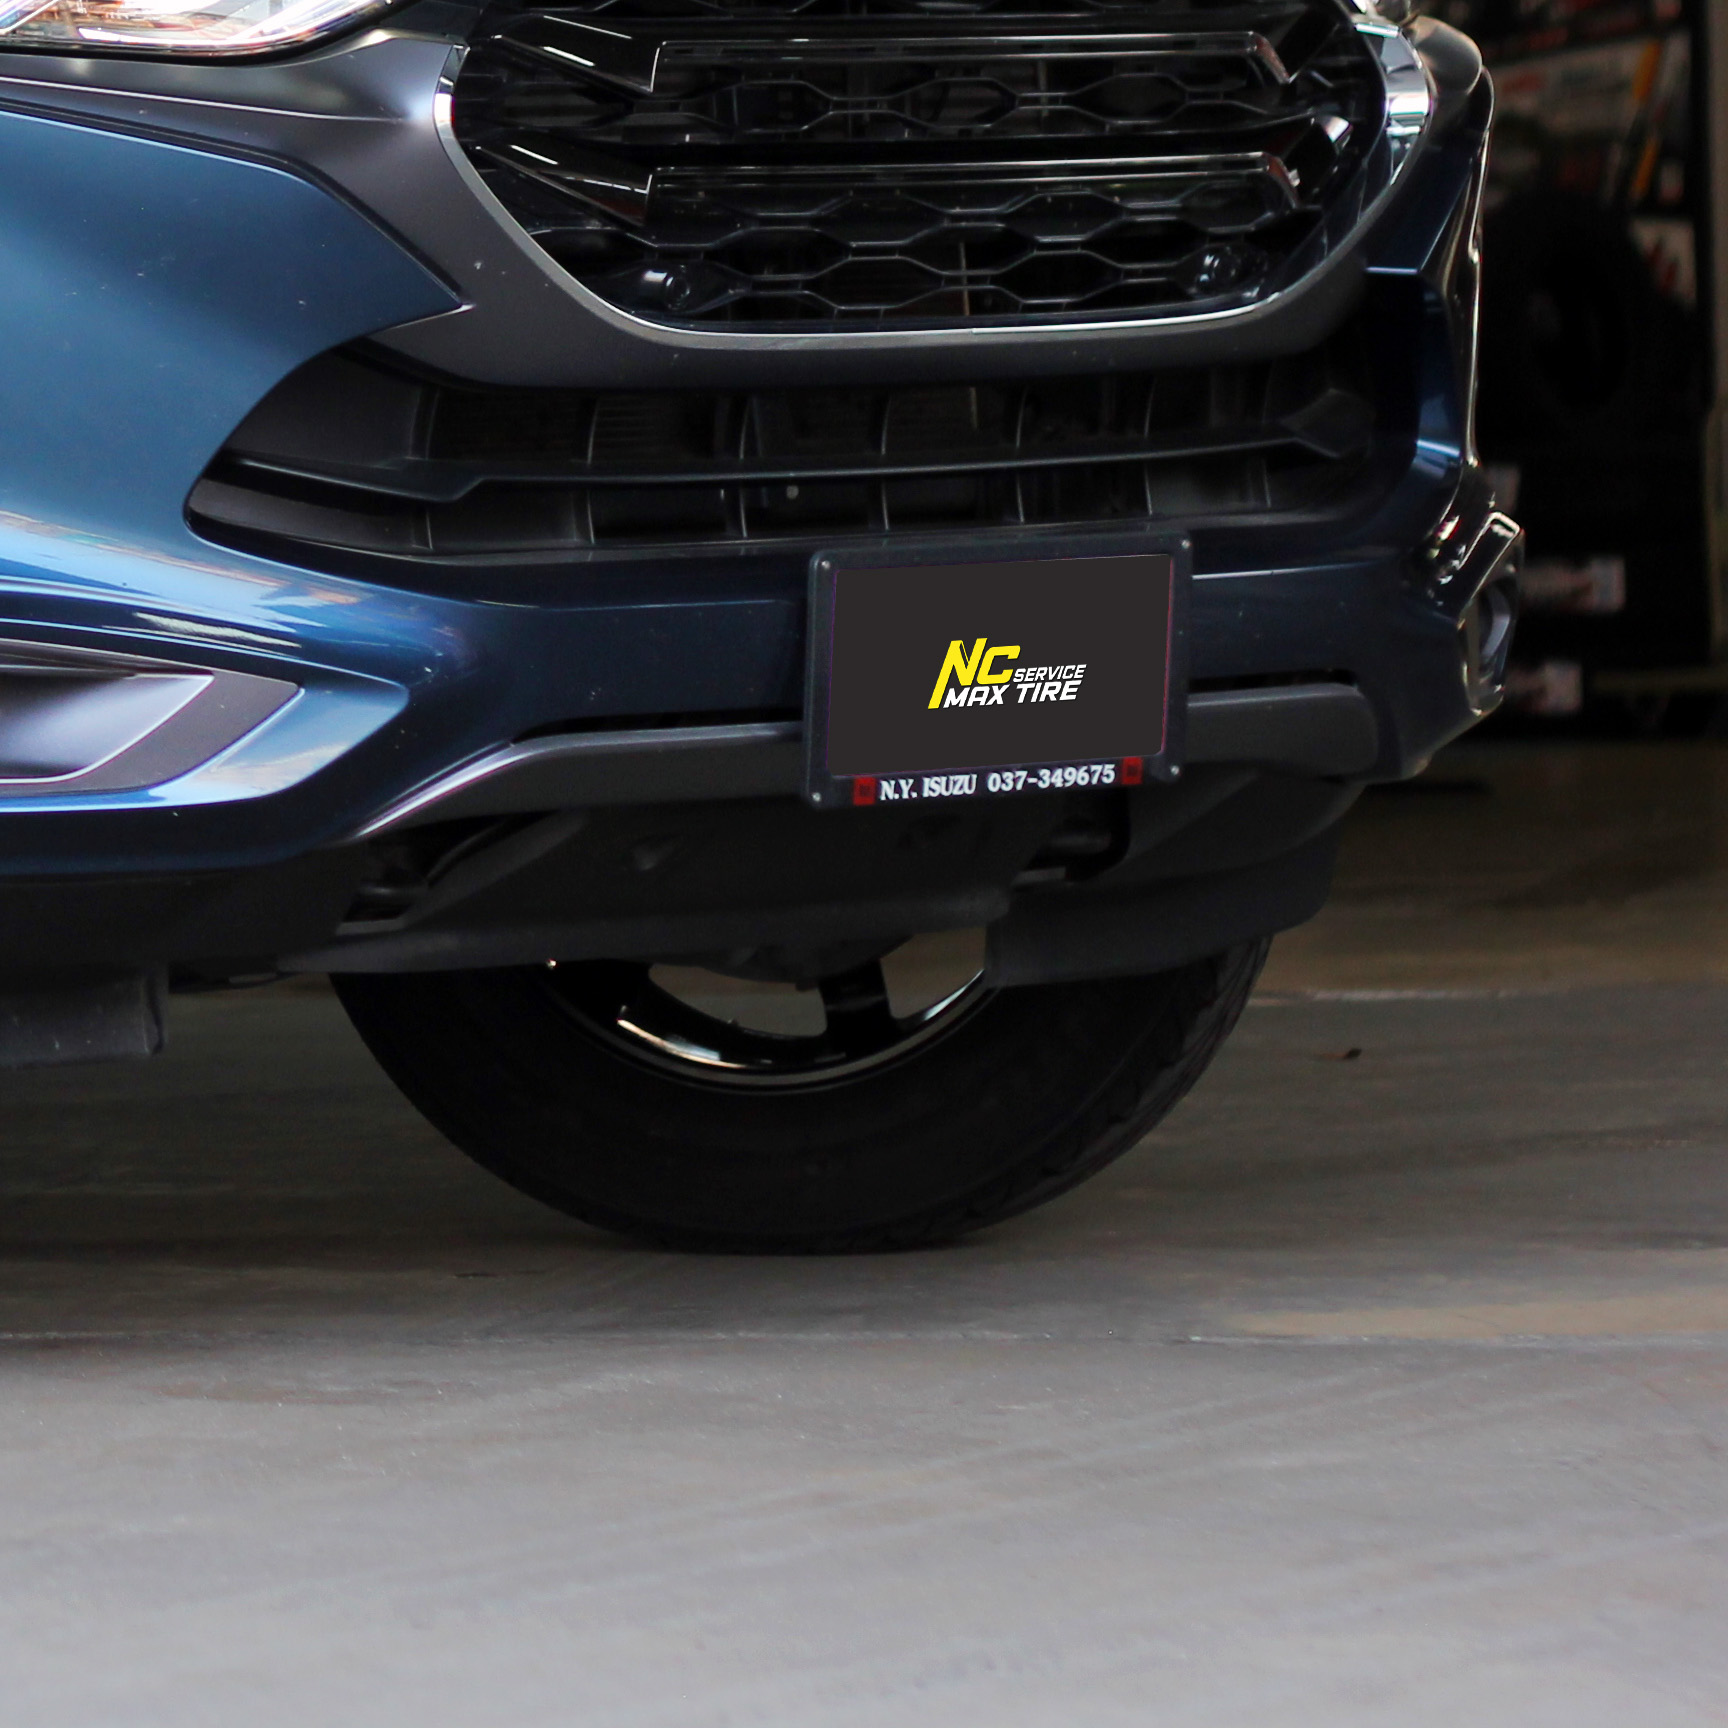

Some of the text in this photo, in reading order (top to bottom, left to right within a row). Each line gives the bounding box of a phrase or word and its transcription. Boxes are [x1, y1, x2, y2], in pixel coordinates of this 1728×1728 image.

[879, 764, 1116, 801] N.Y. ISUZU 037-349675
